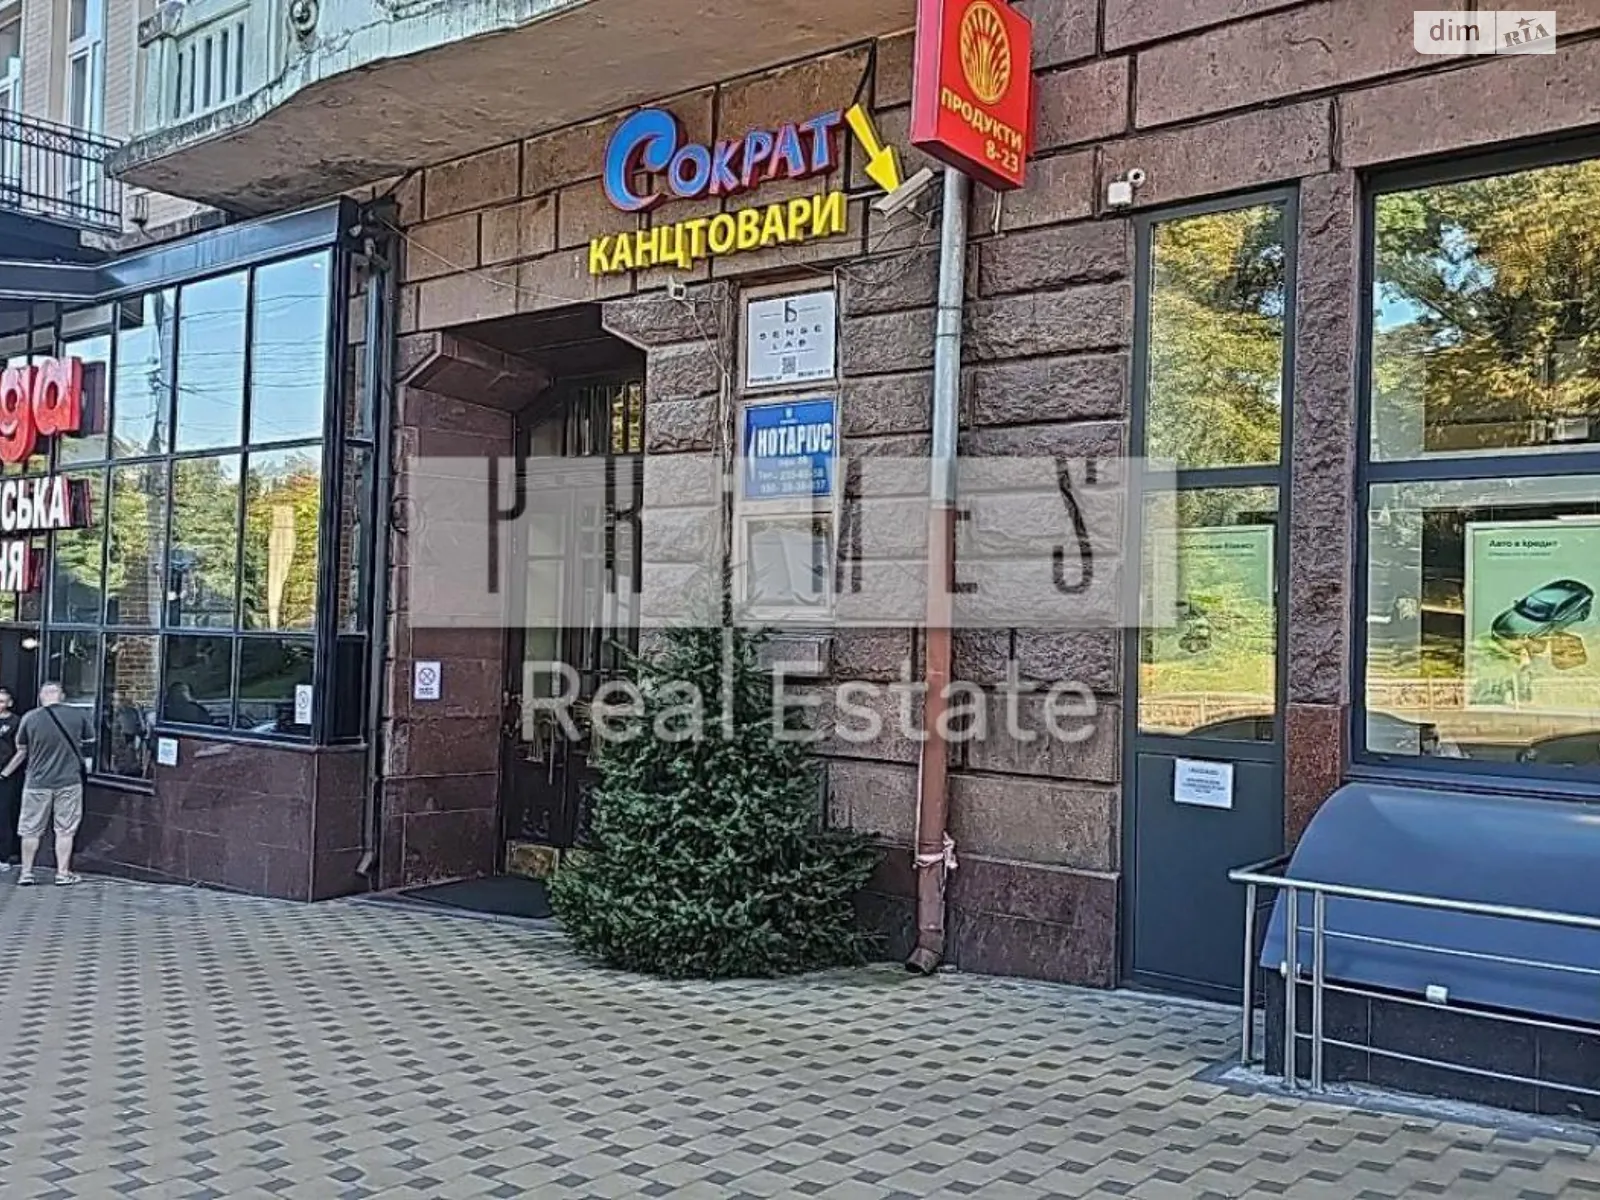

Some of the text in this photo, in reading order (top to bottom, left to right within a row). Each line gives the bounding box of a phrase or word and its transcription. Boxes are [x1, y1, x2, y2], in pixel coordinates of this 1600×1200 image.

[941, 87, 1023, 149] ПРОДУКТИ
[985, 139, 1019, 173] 8-23
[588, 191, 848, 274] КАНЦТОВАРИ
[0, 475, 70, 532] СЬКА
